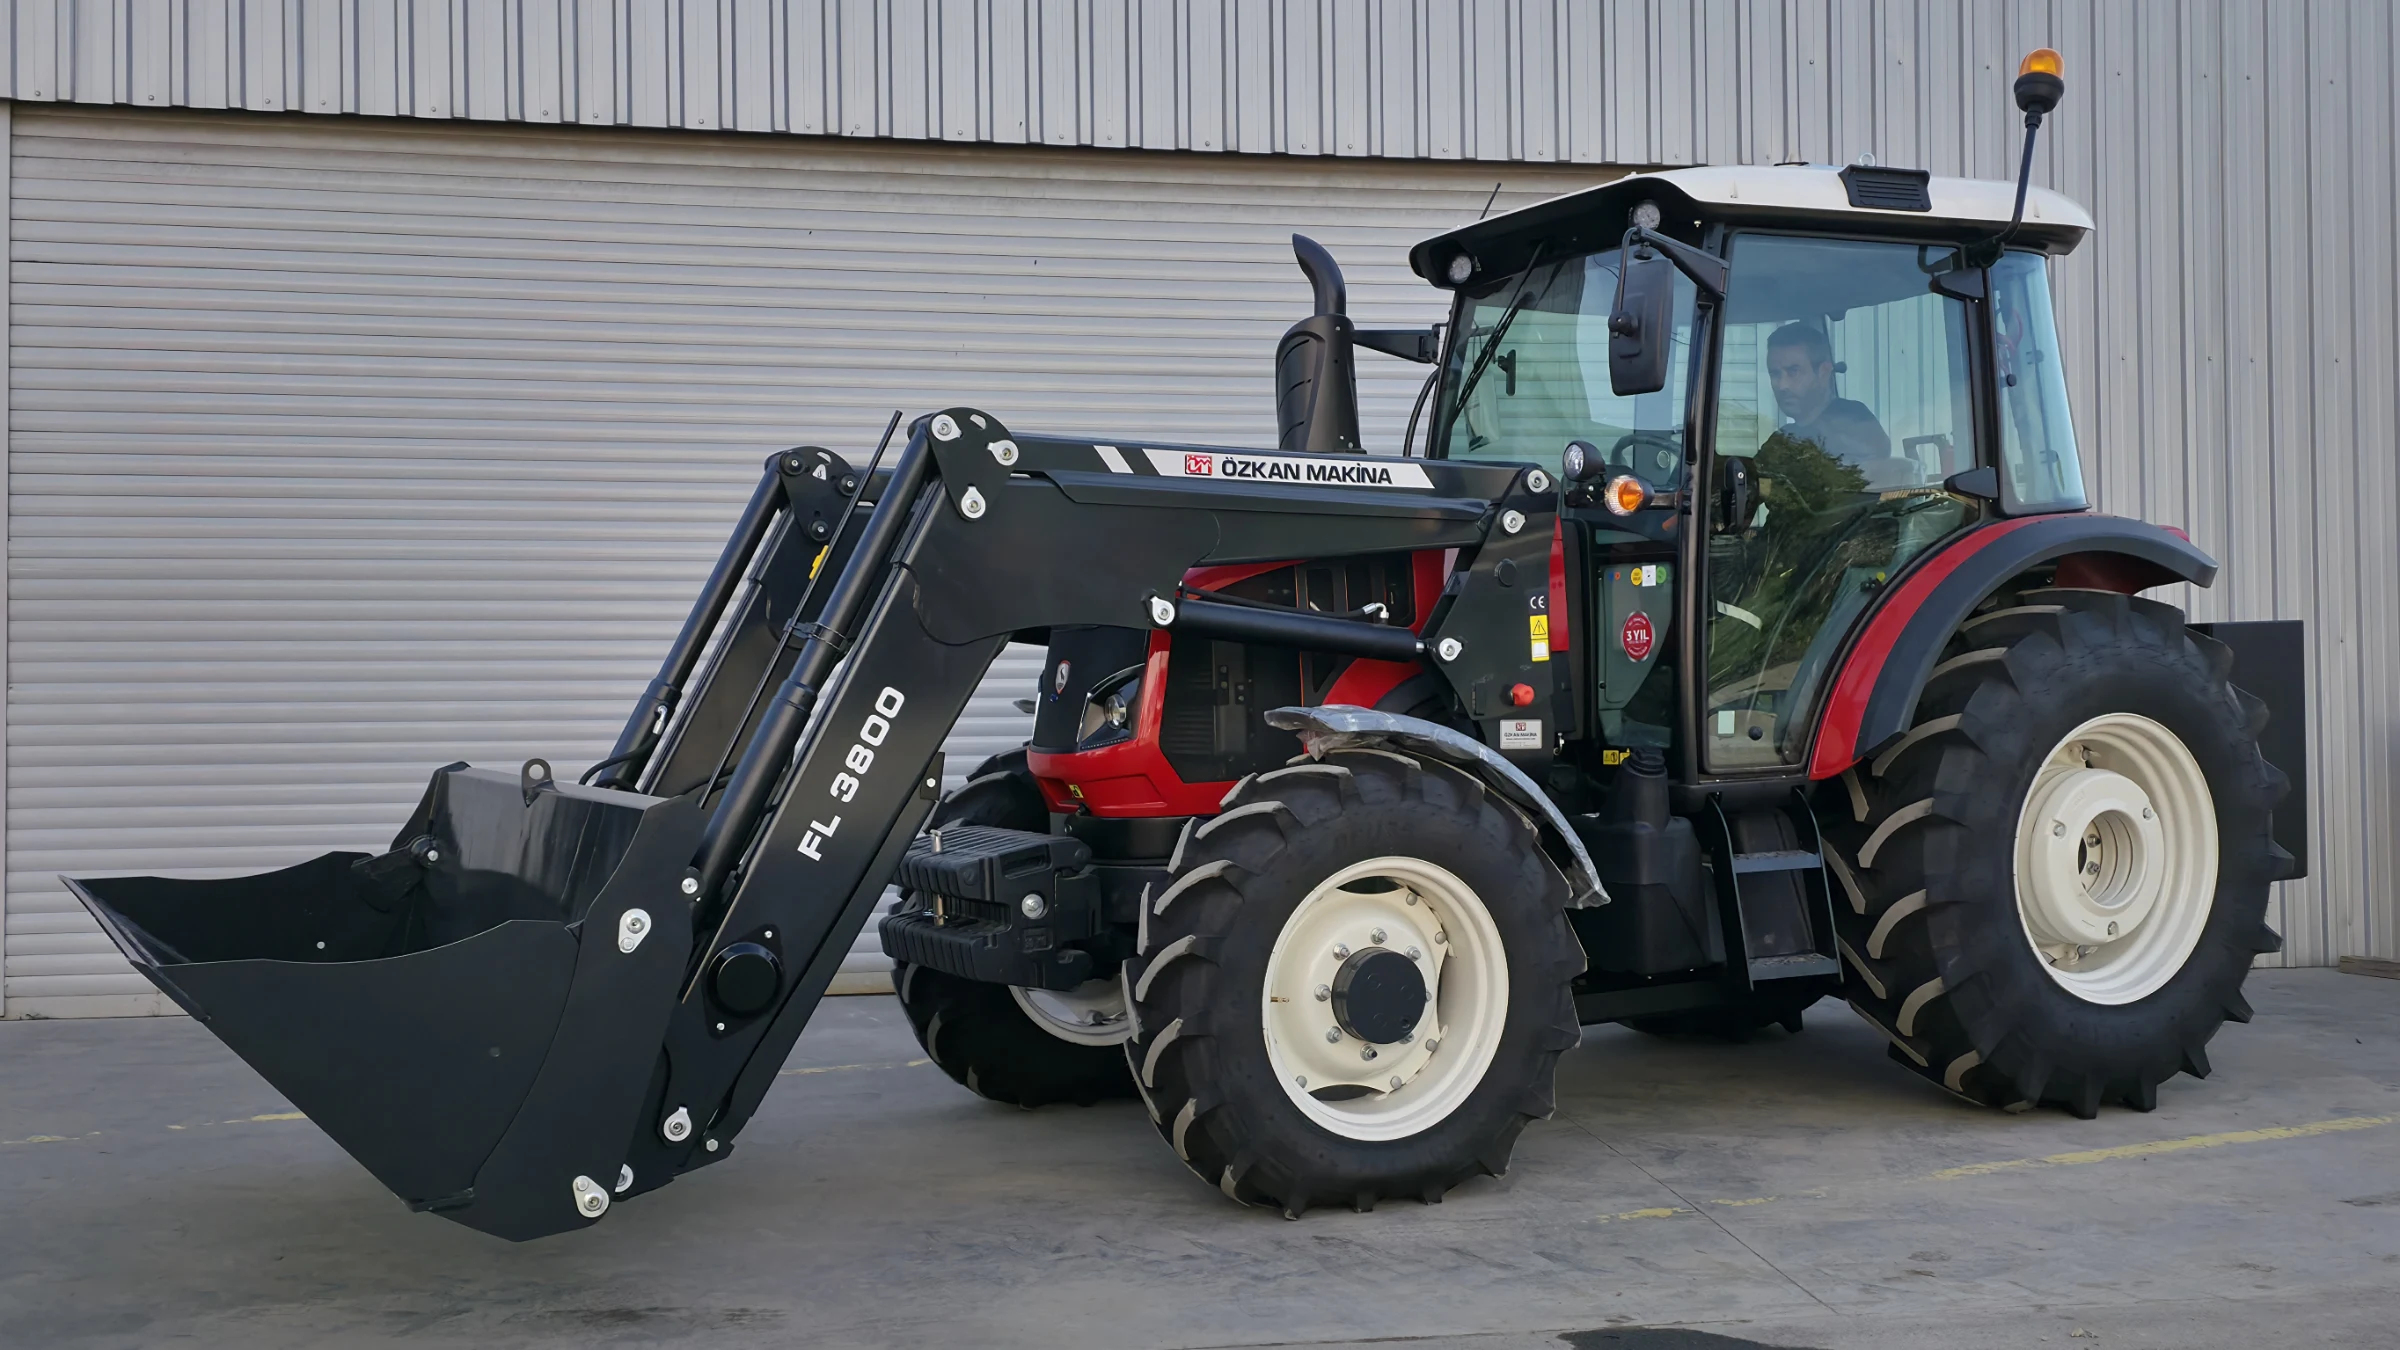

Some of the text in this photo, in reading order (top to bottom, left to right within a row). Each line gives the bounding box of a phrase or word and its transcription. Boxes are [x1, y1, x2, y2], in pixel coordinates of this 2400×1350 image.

[1221, 456, 1300, 480] ÖZKAN
[1306, 463, 1393, 485] MAKİNA
[1626, 629, 1650, 641] 3 YIL
[797, 686, 905, 861] FL 3800
